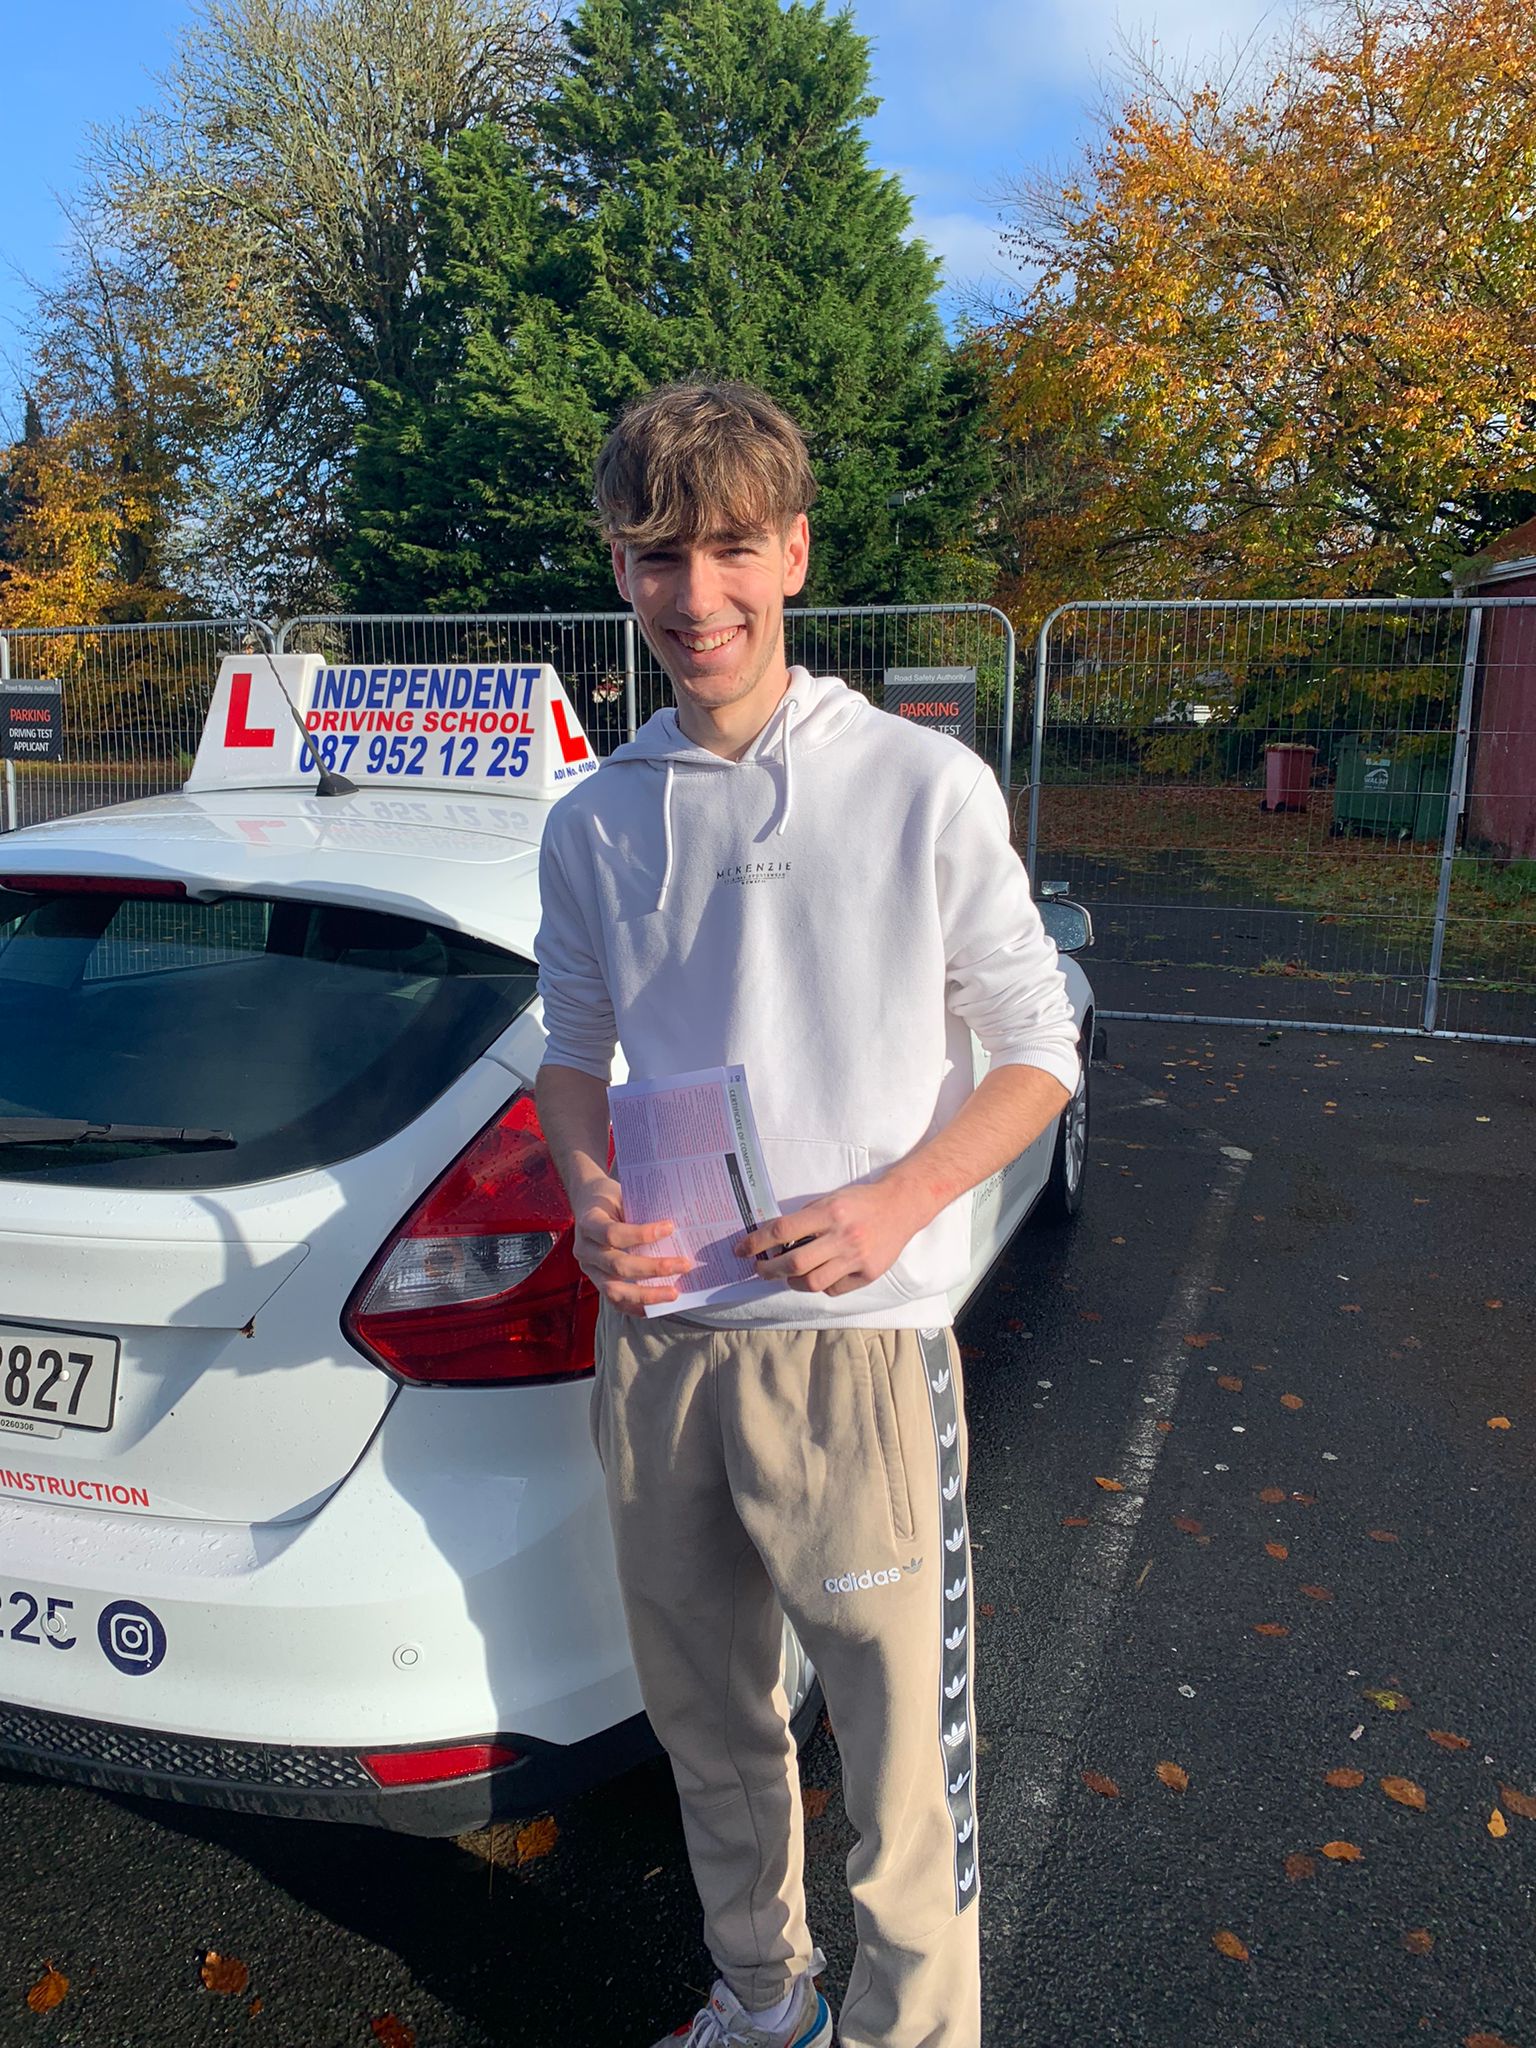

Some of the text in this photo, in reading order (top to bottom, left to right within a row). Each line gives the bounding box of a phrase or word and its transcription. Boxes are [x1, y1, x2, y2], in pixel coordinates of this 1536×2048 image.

[311, 668, 542, 709] INDEPENDENT
[893, 673, 967, 683] Road Safety Authority
[10, 708, 51, 722] PARKING
[224, 673, 275, 748] L
[304, 711, 535, 734] DRIVING SCHOOL
[900, 702, 959, 717] PARKING
[9, 728, 53, 739] DRIVING TEST
[550, 699, 589, 764] L
[938, 725, 960, 735] TEST
[13, 742, 50, 752] APPLICANT
[299, 734, 532, 777] 087 952 12 25
[554, 768, 566, 780] ADI
[729, 1089, 743, 1131] CERTIFICATE
[740, 1142, 757, 1188] COMPETENCY
[0, 1344, 94, 1415] 827
[0, 1468, 150, 1507] INSTRUCTION
[824, 1567, 901, 1594] adidas
[0, 1591, 77, 1650] 25
